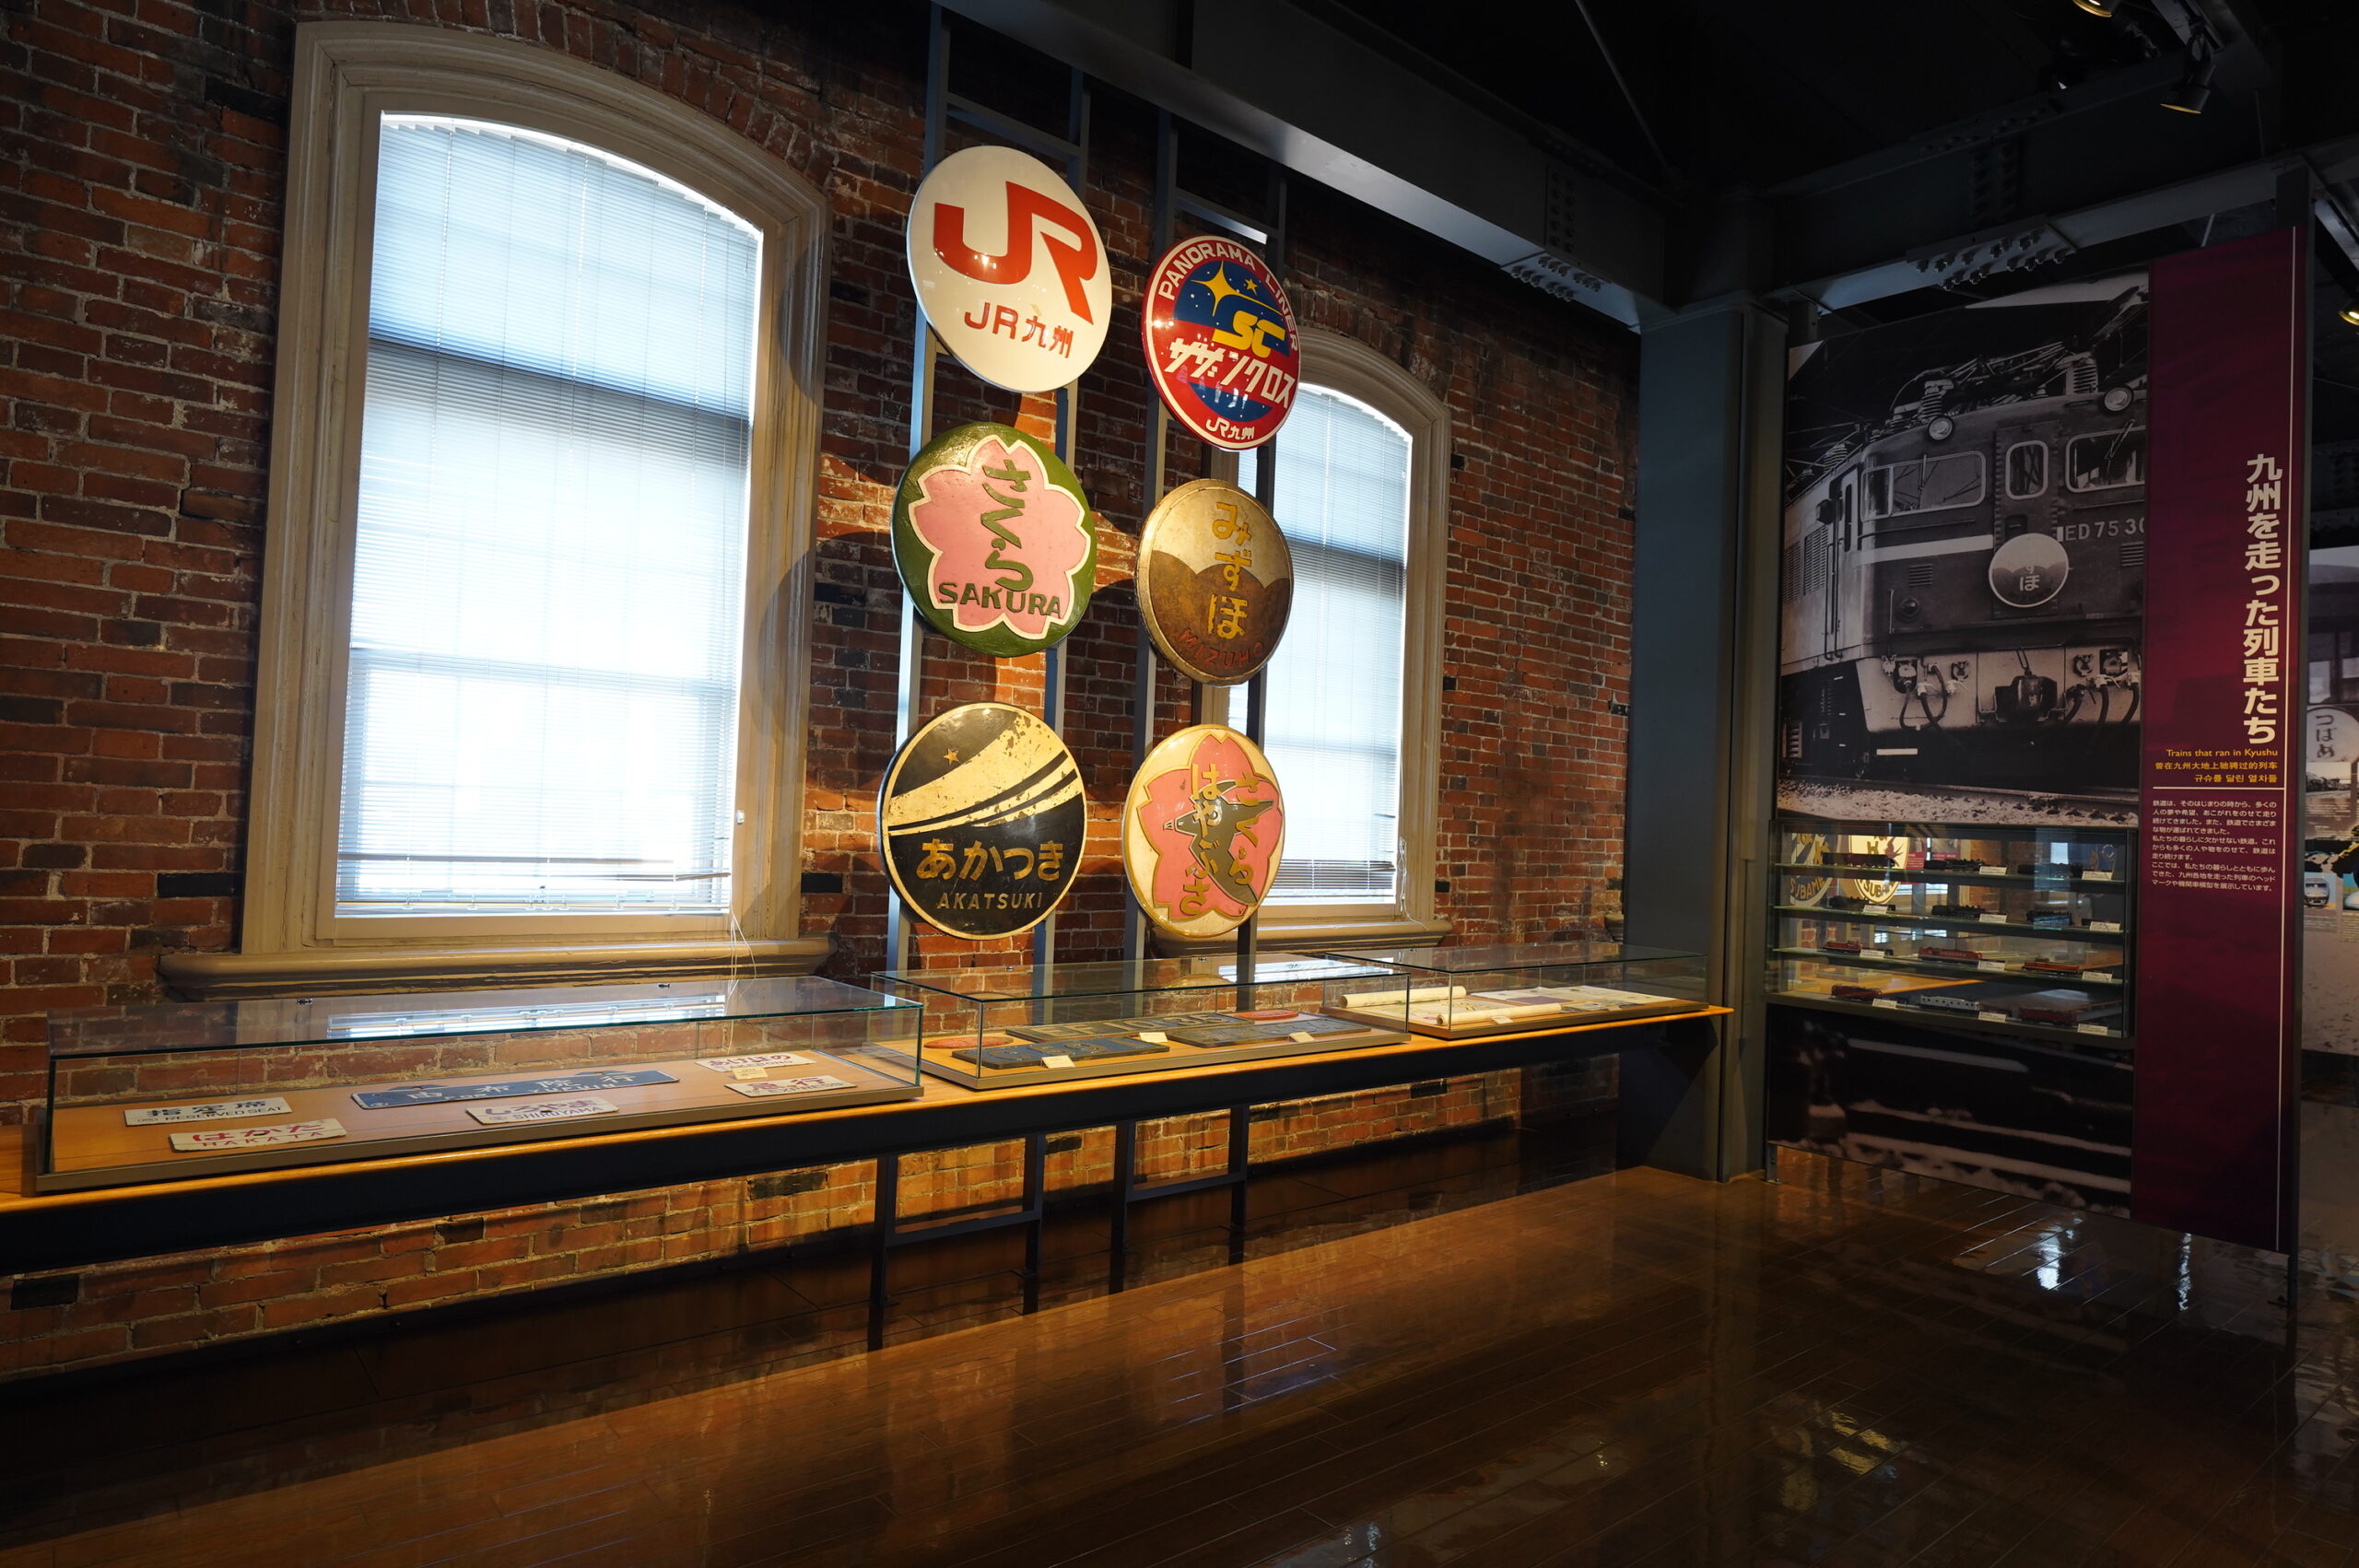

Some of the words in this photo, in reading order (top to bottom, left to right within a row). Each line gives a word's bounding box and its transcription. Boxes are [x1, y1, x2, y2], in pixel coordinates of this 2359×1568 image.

[934, 180, 1097, 325] JR
[1157, 242, 1257, 301] PANORAMA
[1264, 273, 1299, 353] LINER
[964, 301, 1074, 360] JR九州
[1204, 415, 1256, 440] JR九州
[980, 459, 1034, 592] さくら
[1207, 500, 1253, 641] みずほ
[937, 581, 1062, 620] SAKURA
[2242, 453, 2283, 744] 九州を走った列車たち
[1178, 626, 1265, 670] MIZUHO
[2165, 749, 2192, 757] Trains
[2195, 748, 2212, 757] that
[2233, 748, 2242, 756] in
[2244, 748, 2279, 758] Kyushu
[2315, 714, 2337, 759] つばめ
[1180, 763, 1222, 915] はやぶさ
[1227, 770, 1261, 885] さくら
[915, 837, 1064, 883] あかつき
[936, 892, 1043, 910] AKATSUKI
[164, 1109, 245, 1121] RESERVED
[249, 1106, 283, 1115] SEAT
[484, 1099, 599, 1116] しろやま
[512, 1106, 604, 1121] SHIROYAMA
[192, 1123, 325, 1142] はかた
[202, 1131, 324, 1147] HAKATA
